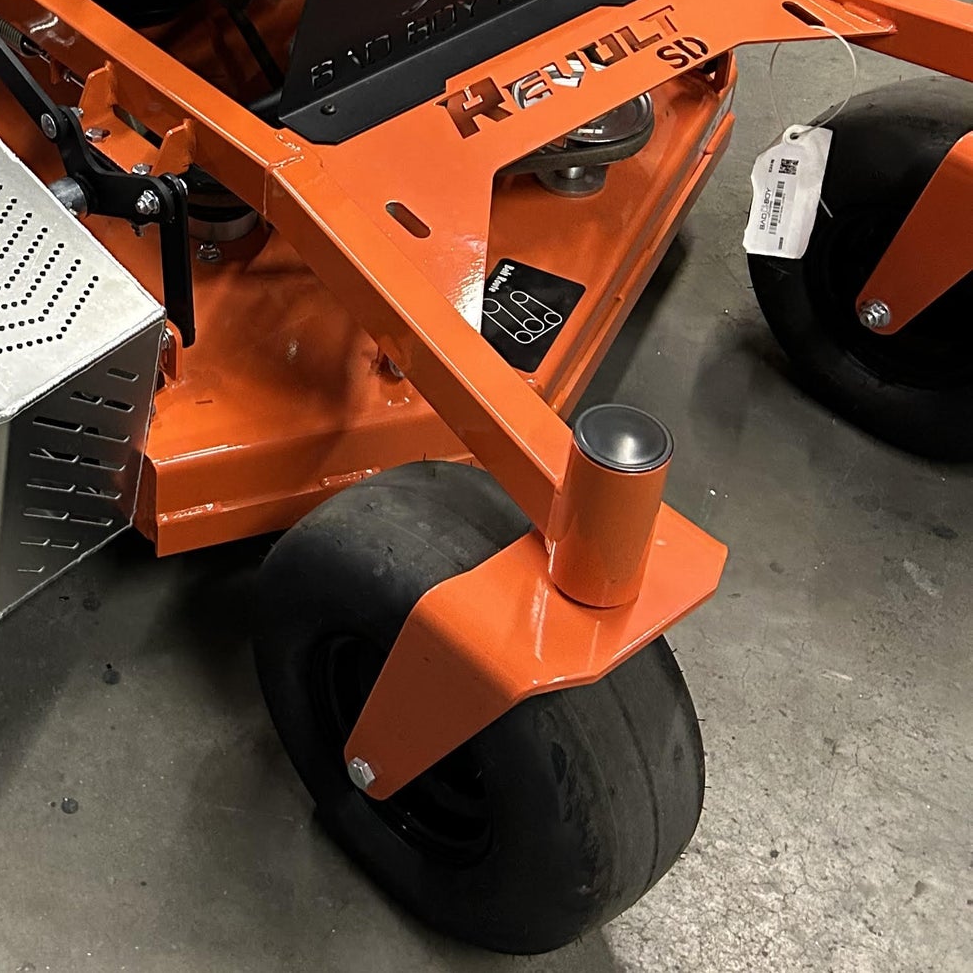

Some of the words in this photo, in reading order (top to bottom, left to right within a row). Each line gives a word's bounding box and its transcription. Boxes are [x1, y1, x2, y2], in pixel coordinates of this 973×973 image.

[656, 36, 710, 70] SD
[759, 211, 768, 230] BAD
[764, 187, 772, 205] BOY
[499, 264, 515, 277] Belt
[488, 275, 508, 293] Route
